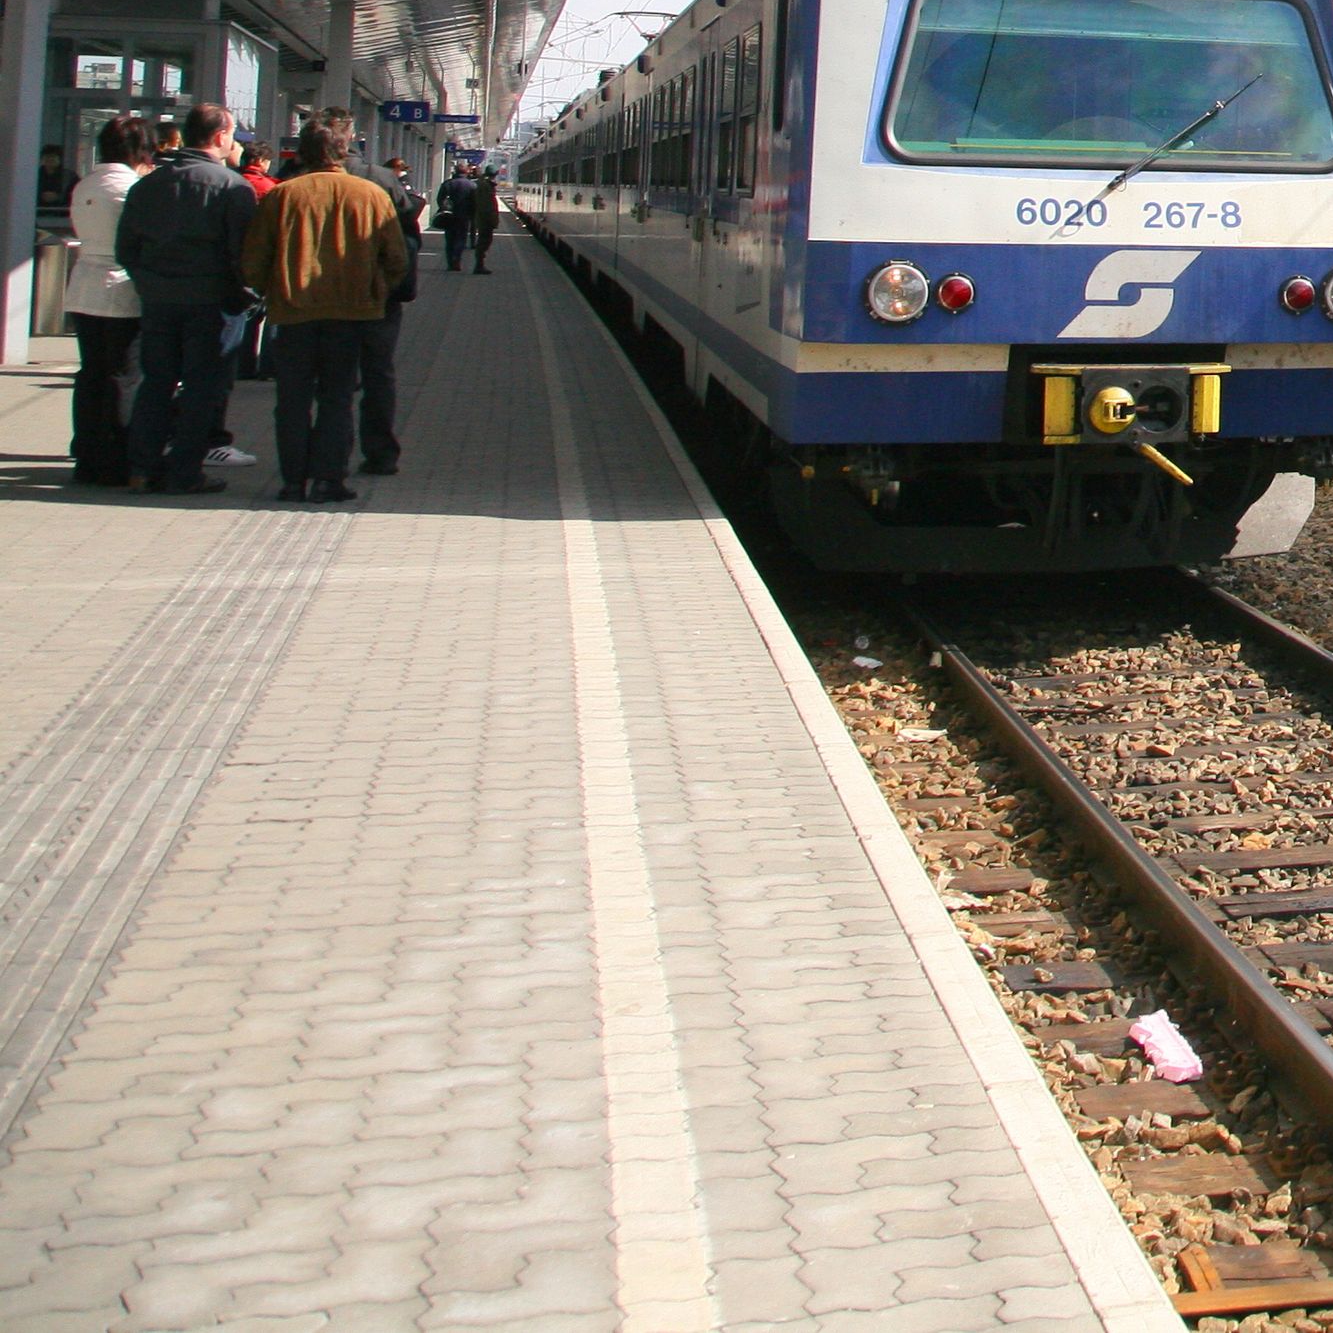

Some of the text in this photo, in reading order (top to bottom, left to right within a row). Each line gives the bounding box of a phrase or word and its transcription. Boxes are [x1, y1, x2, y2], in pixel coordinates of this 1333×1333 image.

[390, 104, 423, 119] 4 B
[1016, 198, 1242, 229] 6020 267-8
